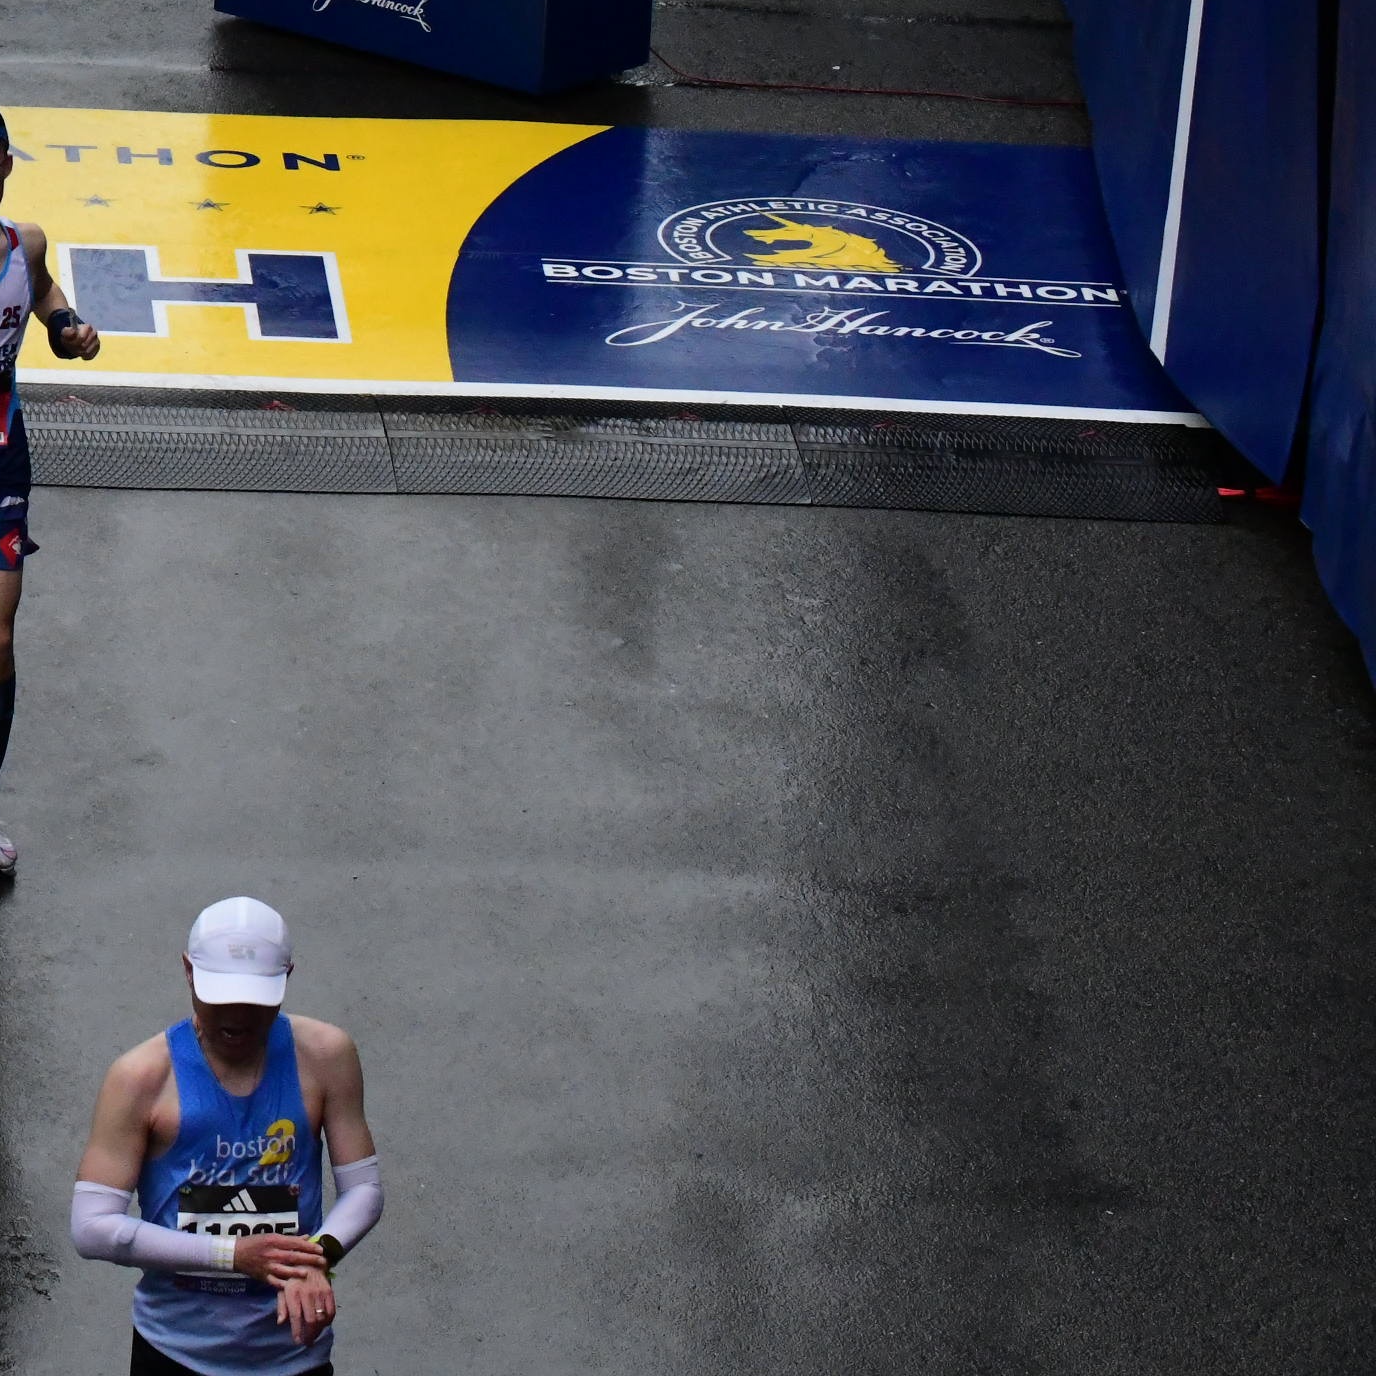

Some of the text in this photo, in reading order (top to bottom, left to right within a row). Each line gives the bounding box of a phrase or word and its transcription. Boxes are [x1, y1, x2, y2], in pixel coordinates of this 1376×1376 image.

[674, 200, 968, 273] BOSTON ATHLETIC ASSOCIATION
[543, 263, 1122, 303] BOSTON MARATHON
[0, 305, 22, 330] 25
[605, 301, 1082, 358] John Hancock
[216, 1134, 296, 1159] boston
